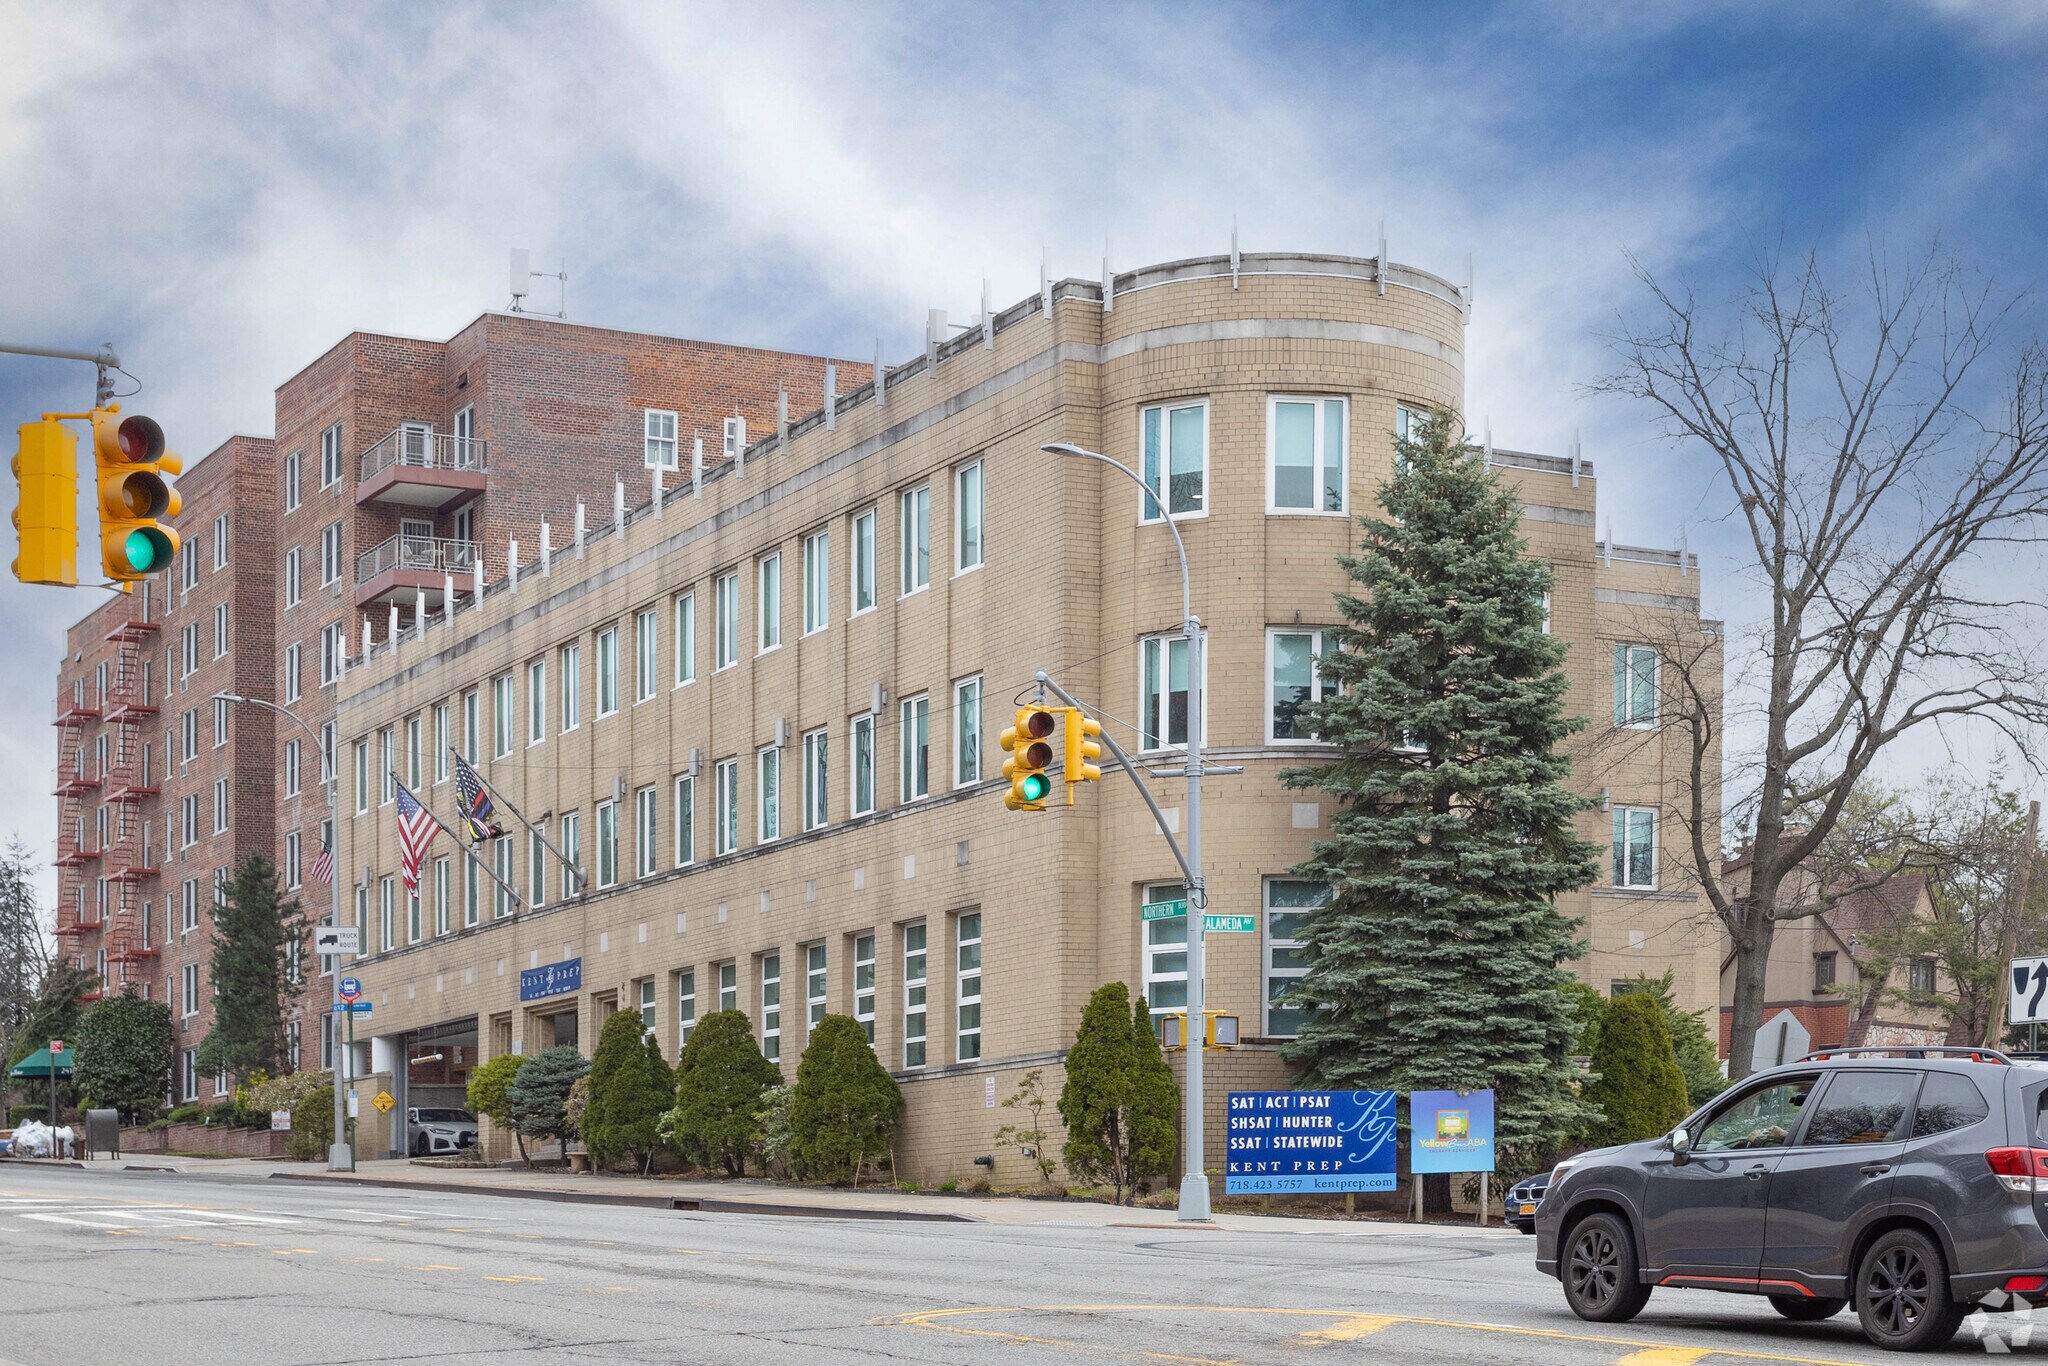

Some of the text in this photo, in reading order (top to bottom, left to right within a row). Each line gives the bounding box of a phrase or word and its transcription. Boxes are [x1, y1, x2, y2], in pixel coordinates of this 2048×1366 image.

[1143, 903, 1174, 919] NORTHERN
[1205, 918, 1242, 930] ALAMEDA
[1231, 1096, 1331, 1109] SAT ACT PSAT
[1231, 1116, 1333, 1129] SHSAT HUNTER
[1230, 1136, 1343, 1149] SSAT STATEWIDE
[1230, 1161, 1343, 1172] KENT PREP
[1229, 1178, 1393, 1190] 718.423.5757 kentprep.com
